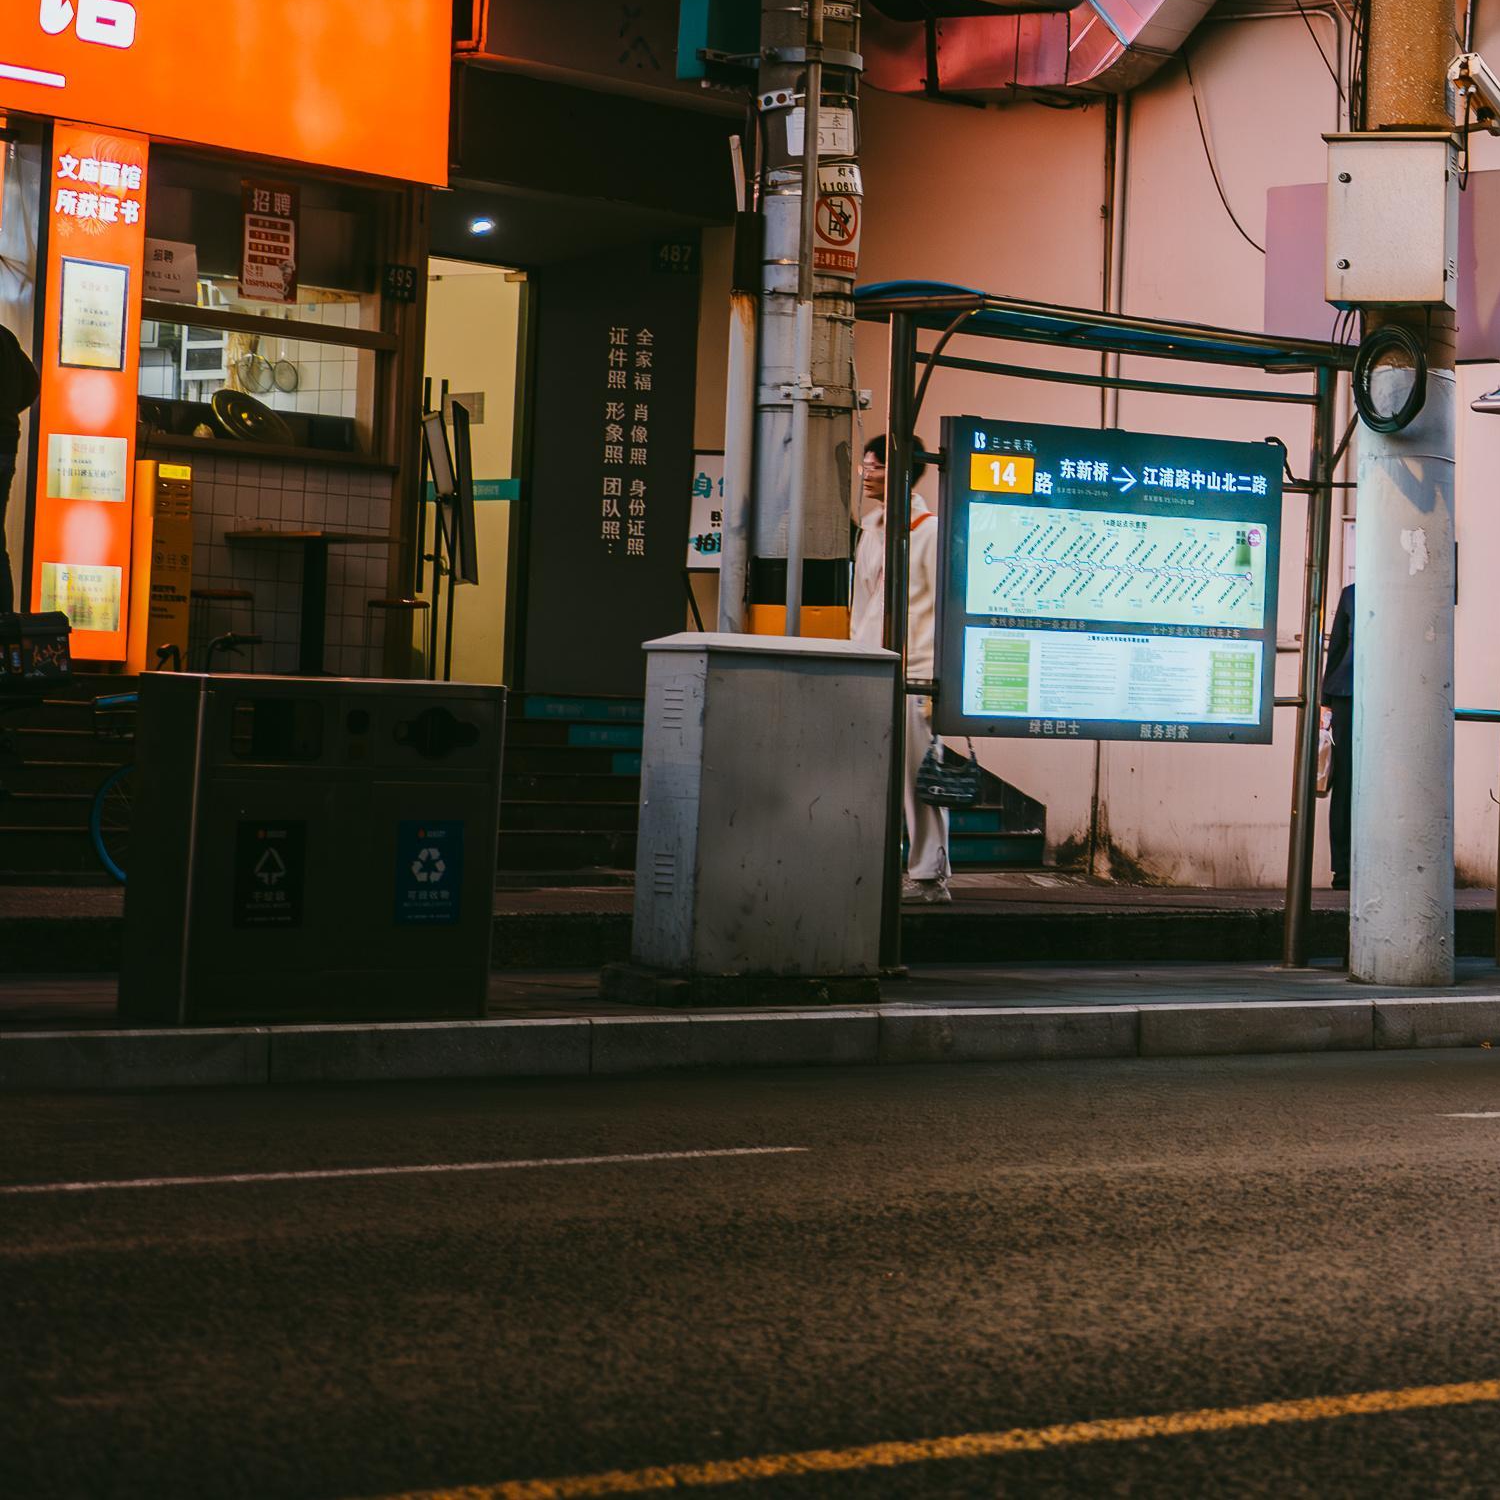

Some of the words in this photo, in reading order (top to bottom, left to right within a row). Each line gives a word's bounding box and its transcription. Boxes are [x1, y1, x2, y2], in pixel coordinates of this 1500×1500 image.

[56, 154, 143, 190] 文庙面馆
[54, 188, 141, 225] 所获证书
[252, 187, 292, 217] 招聘
[659, 243, 692, 262] 487
[388, 267, 413, 288] 495
[607, 325, 629, 390] 证件照
[633, 327, 654, 391] 全家福
[603, 401, 625, 465] 形象照
[628, 403, 649, 466] 肖像照
[990, 460, 1017, 488] 14
[1034, 471, 1054, 496] 路
[1059, 458, 1109, 483] 东新桥
[1142, 466, 1268, 496] 江浦路中山北二路
[626, 478, 647, 557] 身份证照
[1028, 720, 1080, 736] 绿色巴士
[1139, 723, 1191, 740] 服务到家
